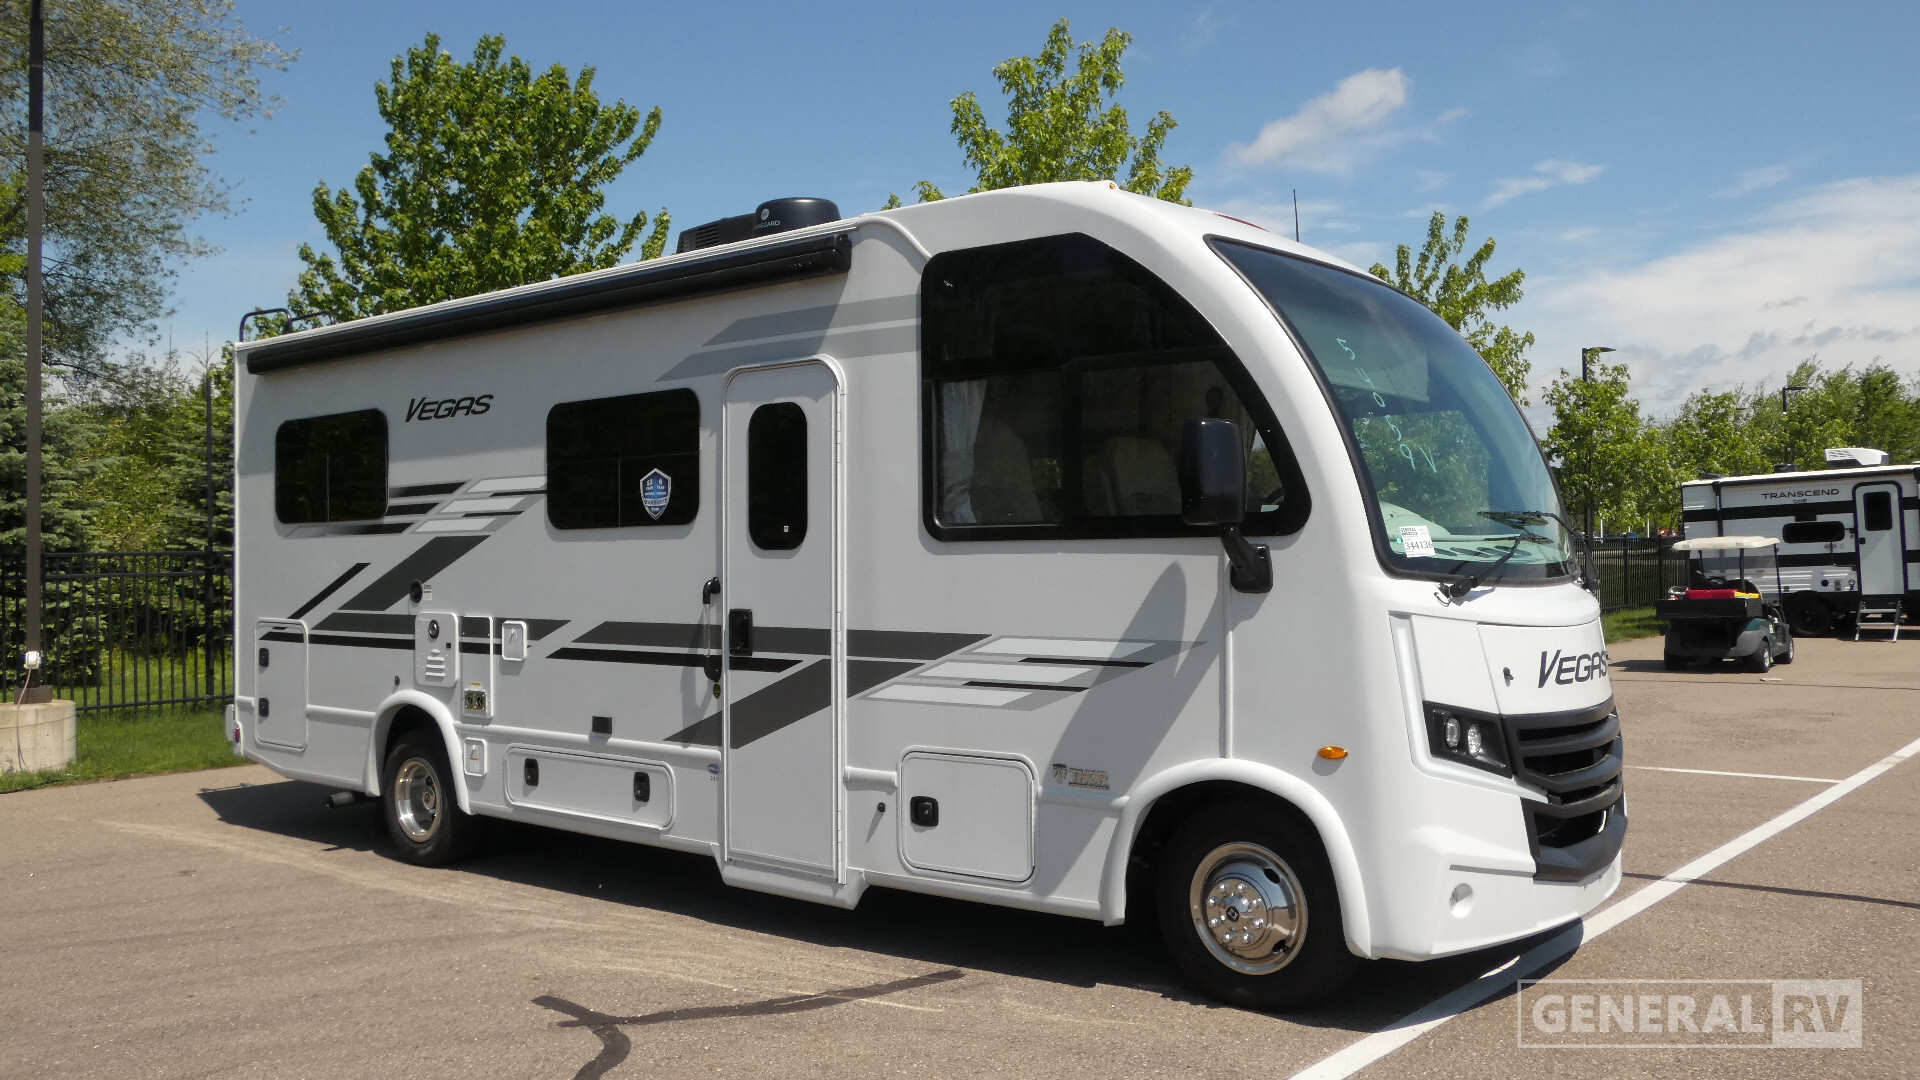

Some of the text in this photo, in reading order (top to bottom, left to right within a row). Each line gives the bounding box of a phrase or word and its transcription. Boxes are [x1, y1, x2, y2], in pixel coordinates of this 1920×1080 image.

[405, 394, 494, 423] VEGAS
[1761, 488, 1840, 500] TRANSCEND
[1537, 649, 1609, 689] VEGAS
